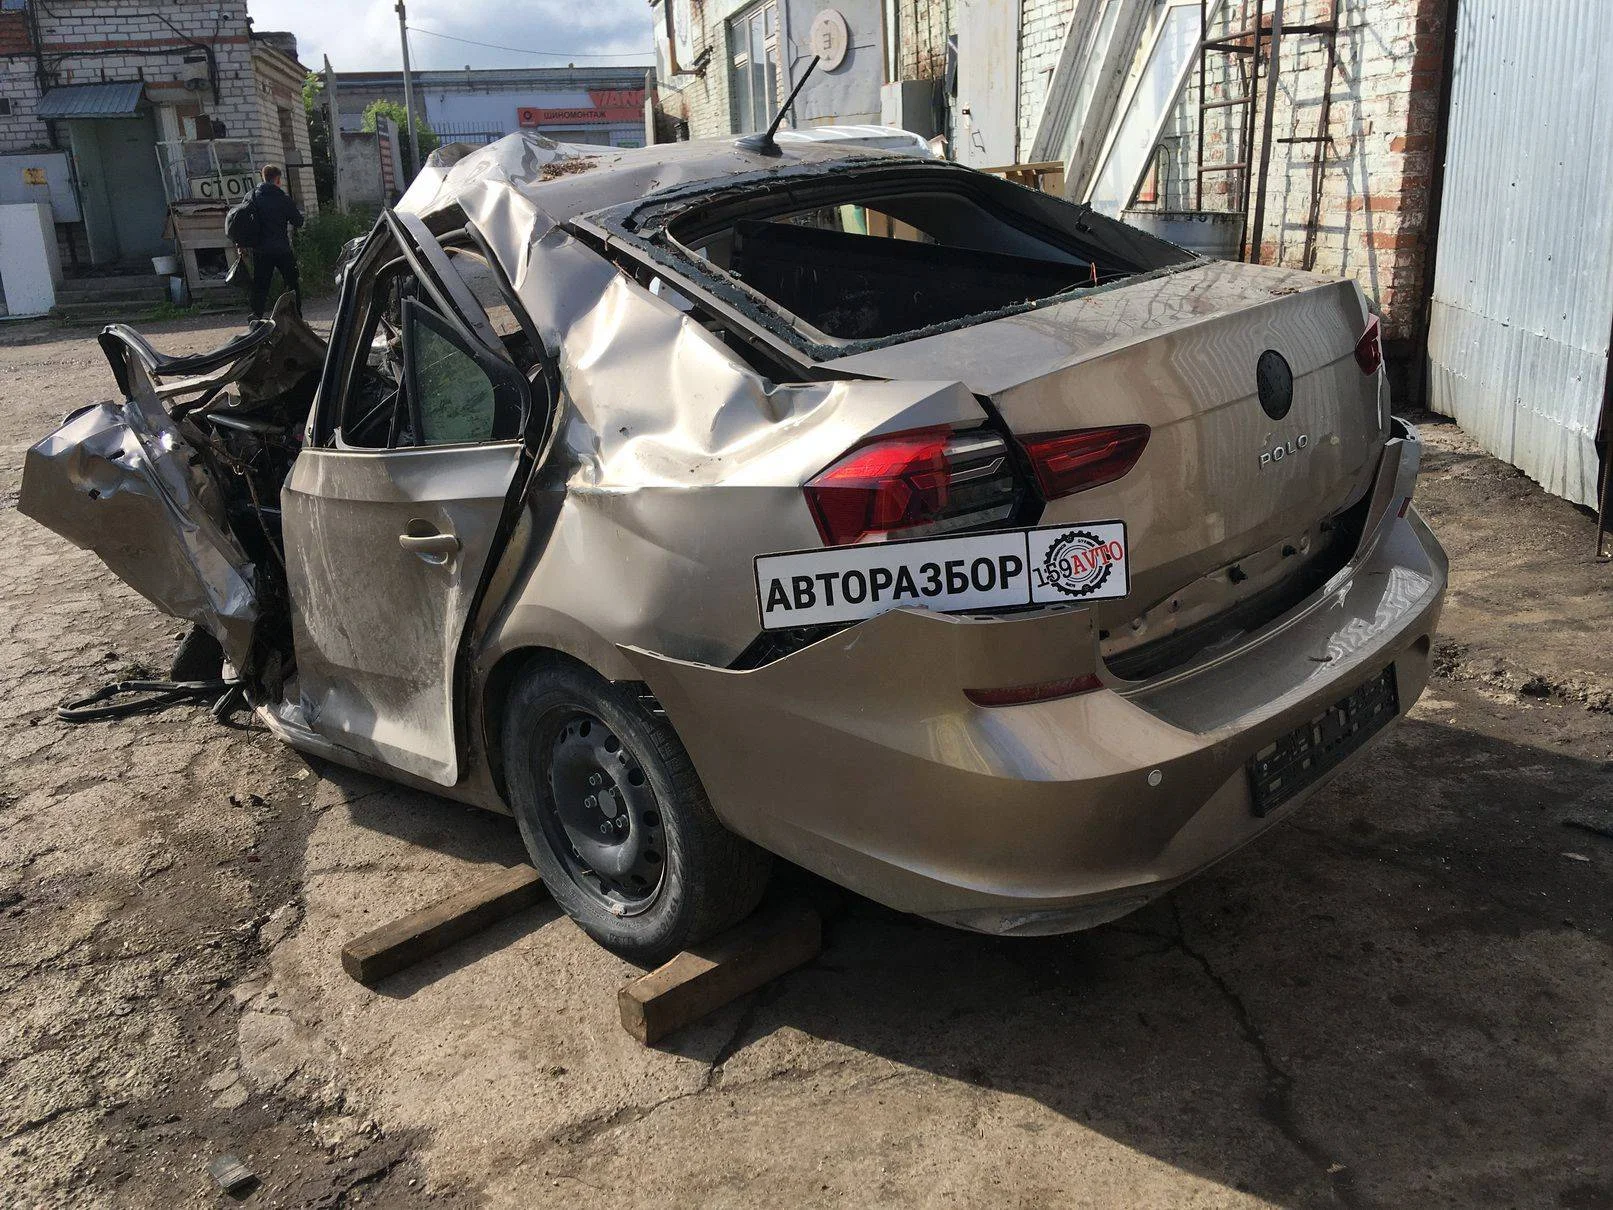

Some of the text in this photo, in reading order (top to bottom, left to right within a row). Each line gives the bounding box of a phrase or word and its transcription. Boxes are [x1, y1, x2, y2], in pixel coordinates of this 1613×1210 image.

[543, 110, 607, 120] ШИНОМОНТАЖ
[1259, 434, 1308, 470] POLO
[765, 555, 1023, 612] АВТОРАЗБОР
